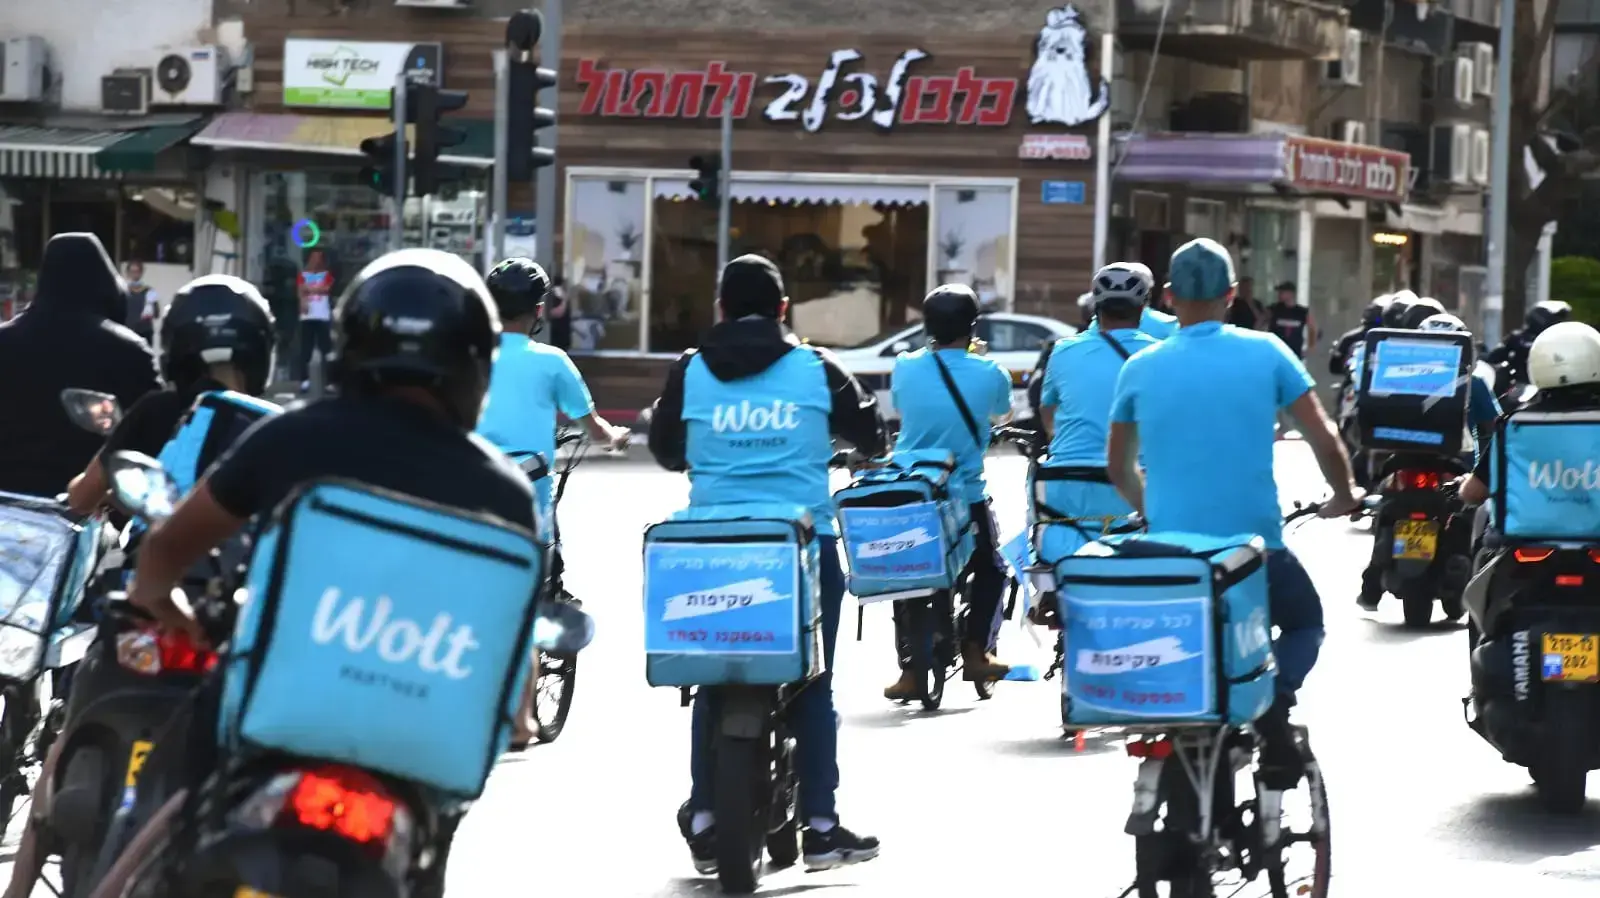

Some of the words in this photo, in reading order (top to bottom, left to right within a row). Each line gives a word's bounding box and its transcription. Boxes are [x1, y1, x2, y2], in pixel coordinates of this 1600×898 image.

[306, 58, 338, 70] HIGH
[342, 58, 381, 71] TECH
[575, 58, 757, 119] ולחתול
[763, 48, 930, 133] לכלב
[900, 66, 1019, 126] כלבו
[711, 399, 803, 433] Wolt
[728, 436, 789, 450] PARTNER
[685, 593, 755, 610] שקיפות
[311, 584, 480, 680] Wolt
[1160, 613, 1193, 629] לכל
[1091, 652, 1161, 669] שקיפות
[1512, 630, 1530, 701] YAMAHA
